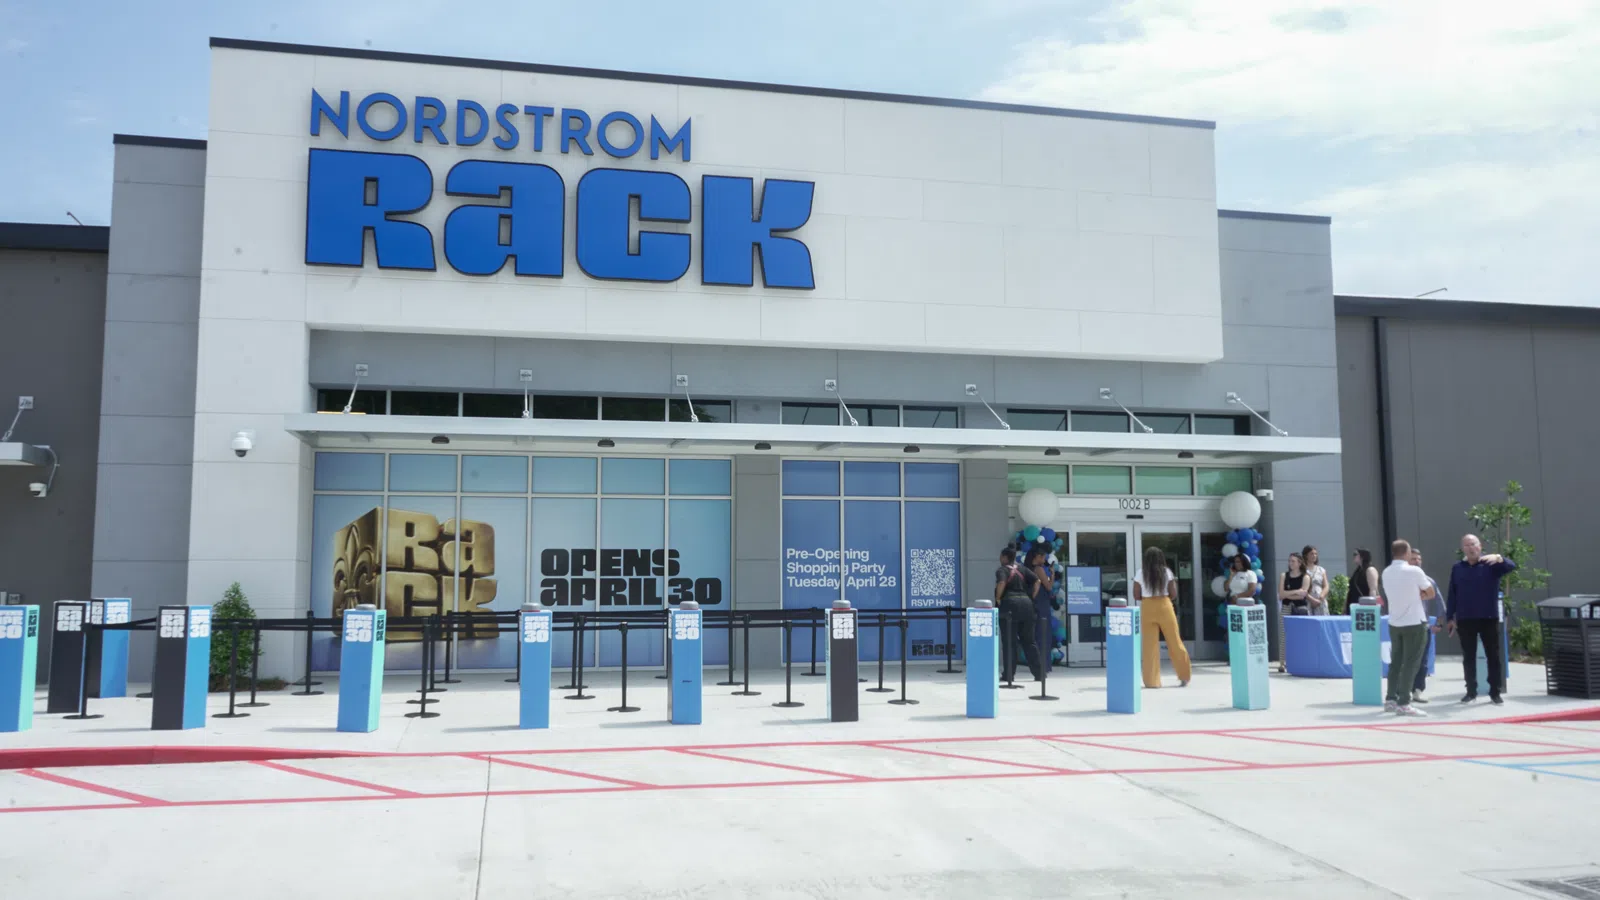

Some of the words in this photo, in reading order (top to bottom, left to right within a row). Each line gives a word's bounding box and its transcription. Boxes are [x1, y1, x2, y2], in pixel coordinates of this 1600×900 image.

[309, 88, 692, 162] NORDSTROM
[304, 148, 815, 289] RaCK
[1119, 499, 1140, 510] 1002
[1144, 499, 1151, 510] B
[541, 549, 680, 576] OPENS
[787, 562, 848, 576] Shopping
[852, 562, 885, 576] Party
[787, 576, 841, 589] Tuesday
[847, 576, 876, 589] April
[879, 577, 897, 587] 28
[540, 578, 662, 606] aPRIL
[668, 578, 722, 606] 30
[911, 599, 934, 607] RSVP
[936, 599, 956, 607] Here
[345, 629, 371, 642] 30
[524, 629, 549, 642] 30
[675, 628, 699, 640] 30
[969, 625, 993, 637] 30
[1109, 624, 1132, 636] 30
